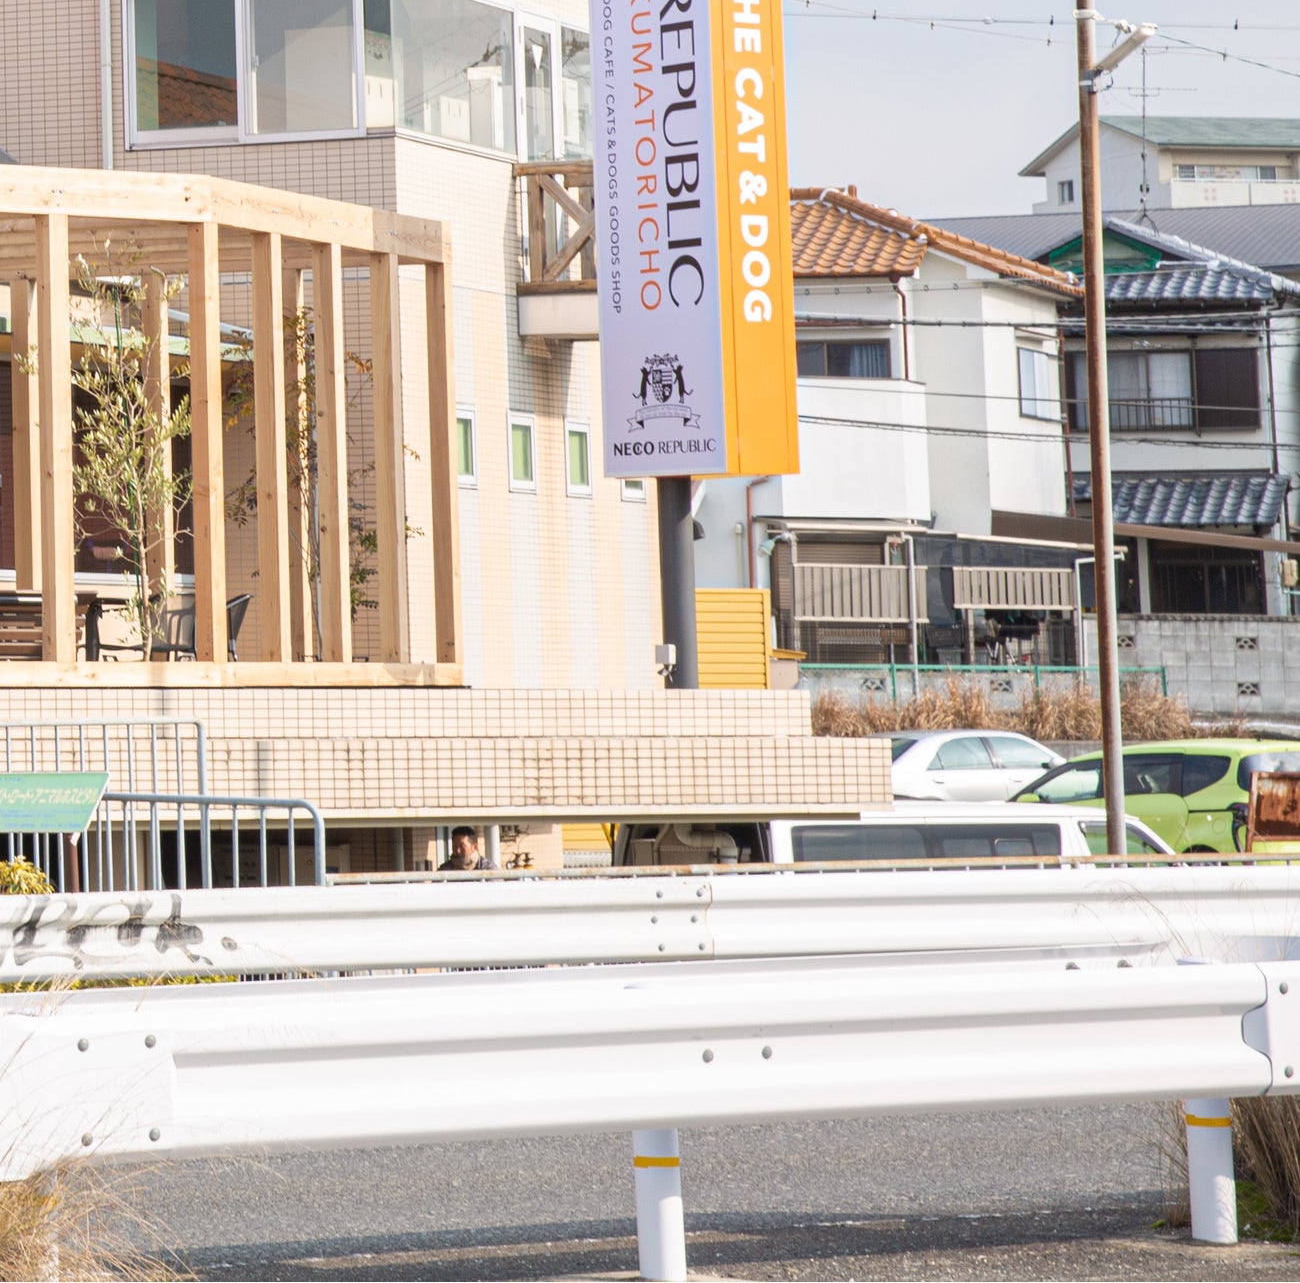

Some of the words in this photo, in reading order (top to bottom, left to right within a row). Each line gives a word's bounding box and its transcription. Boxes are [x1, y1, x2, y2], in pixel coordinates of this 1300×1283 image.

[603, 36, 615, 78] CAFE
[734, 67, 766, 163] CAT
[738, 170, 768, 205] &
[609, 205, 621, 266] GOODS
[740, 214, 773, 323] DOG
[611, 270, 622, 314] SHOP
[658, 438, 717, 455] REPUBLIC
